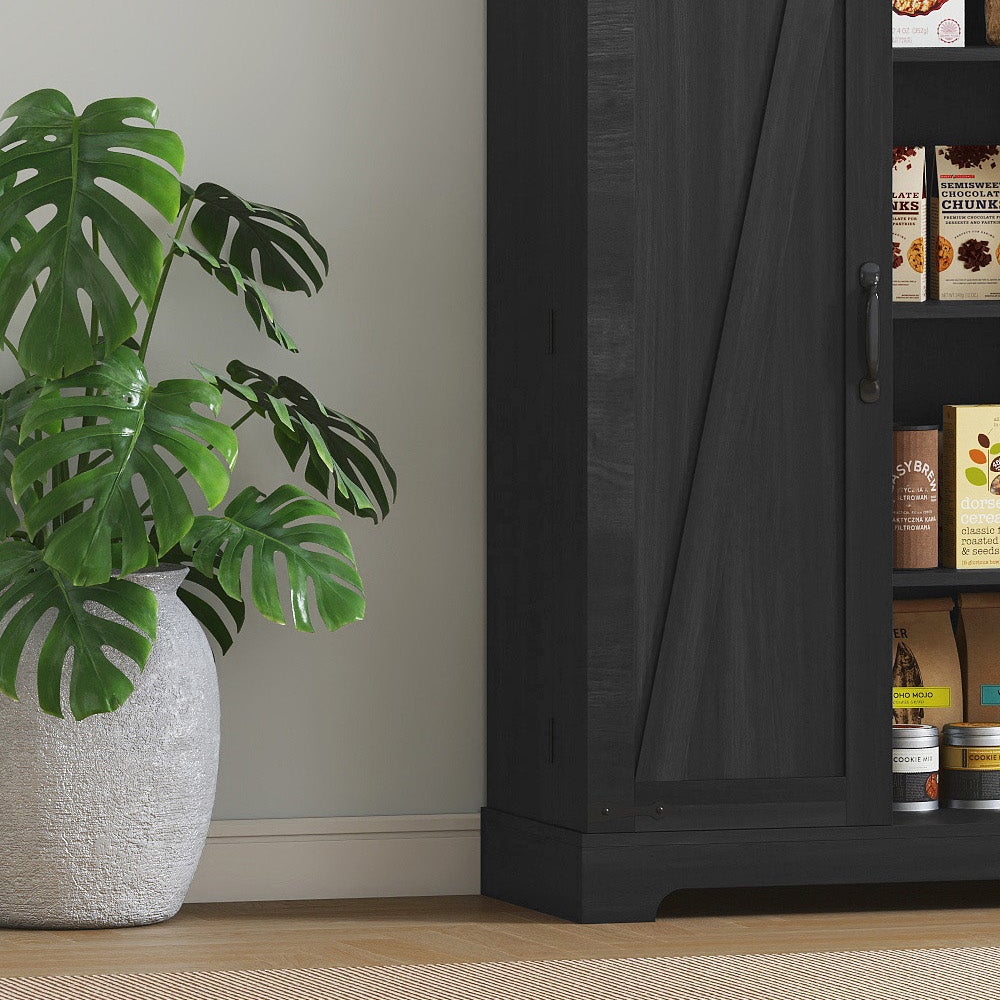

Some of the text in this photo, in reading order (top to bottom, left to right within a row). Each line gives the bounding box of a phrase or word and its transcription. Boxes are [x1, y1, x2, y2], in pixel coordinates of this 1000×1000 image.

[961, 526, 995, 535] classic
[961, 536, 999, 546] roasted
[961, 547, 1000, 556] & seeds
[893, 628, 908, 639] ER
